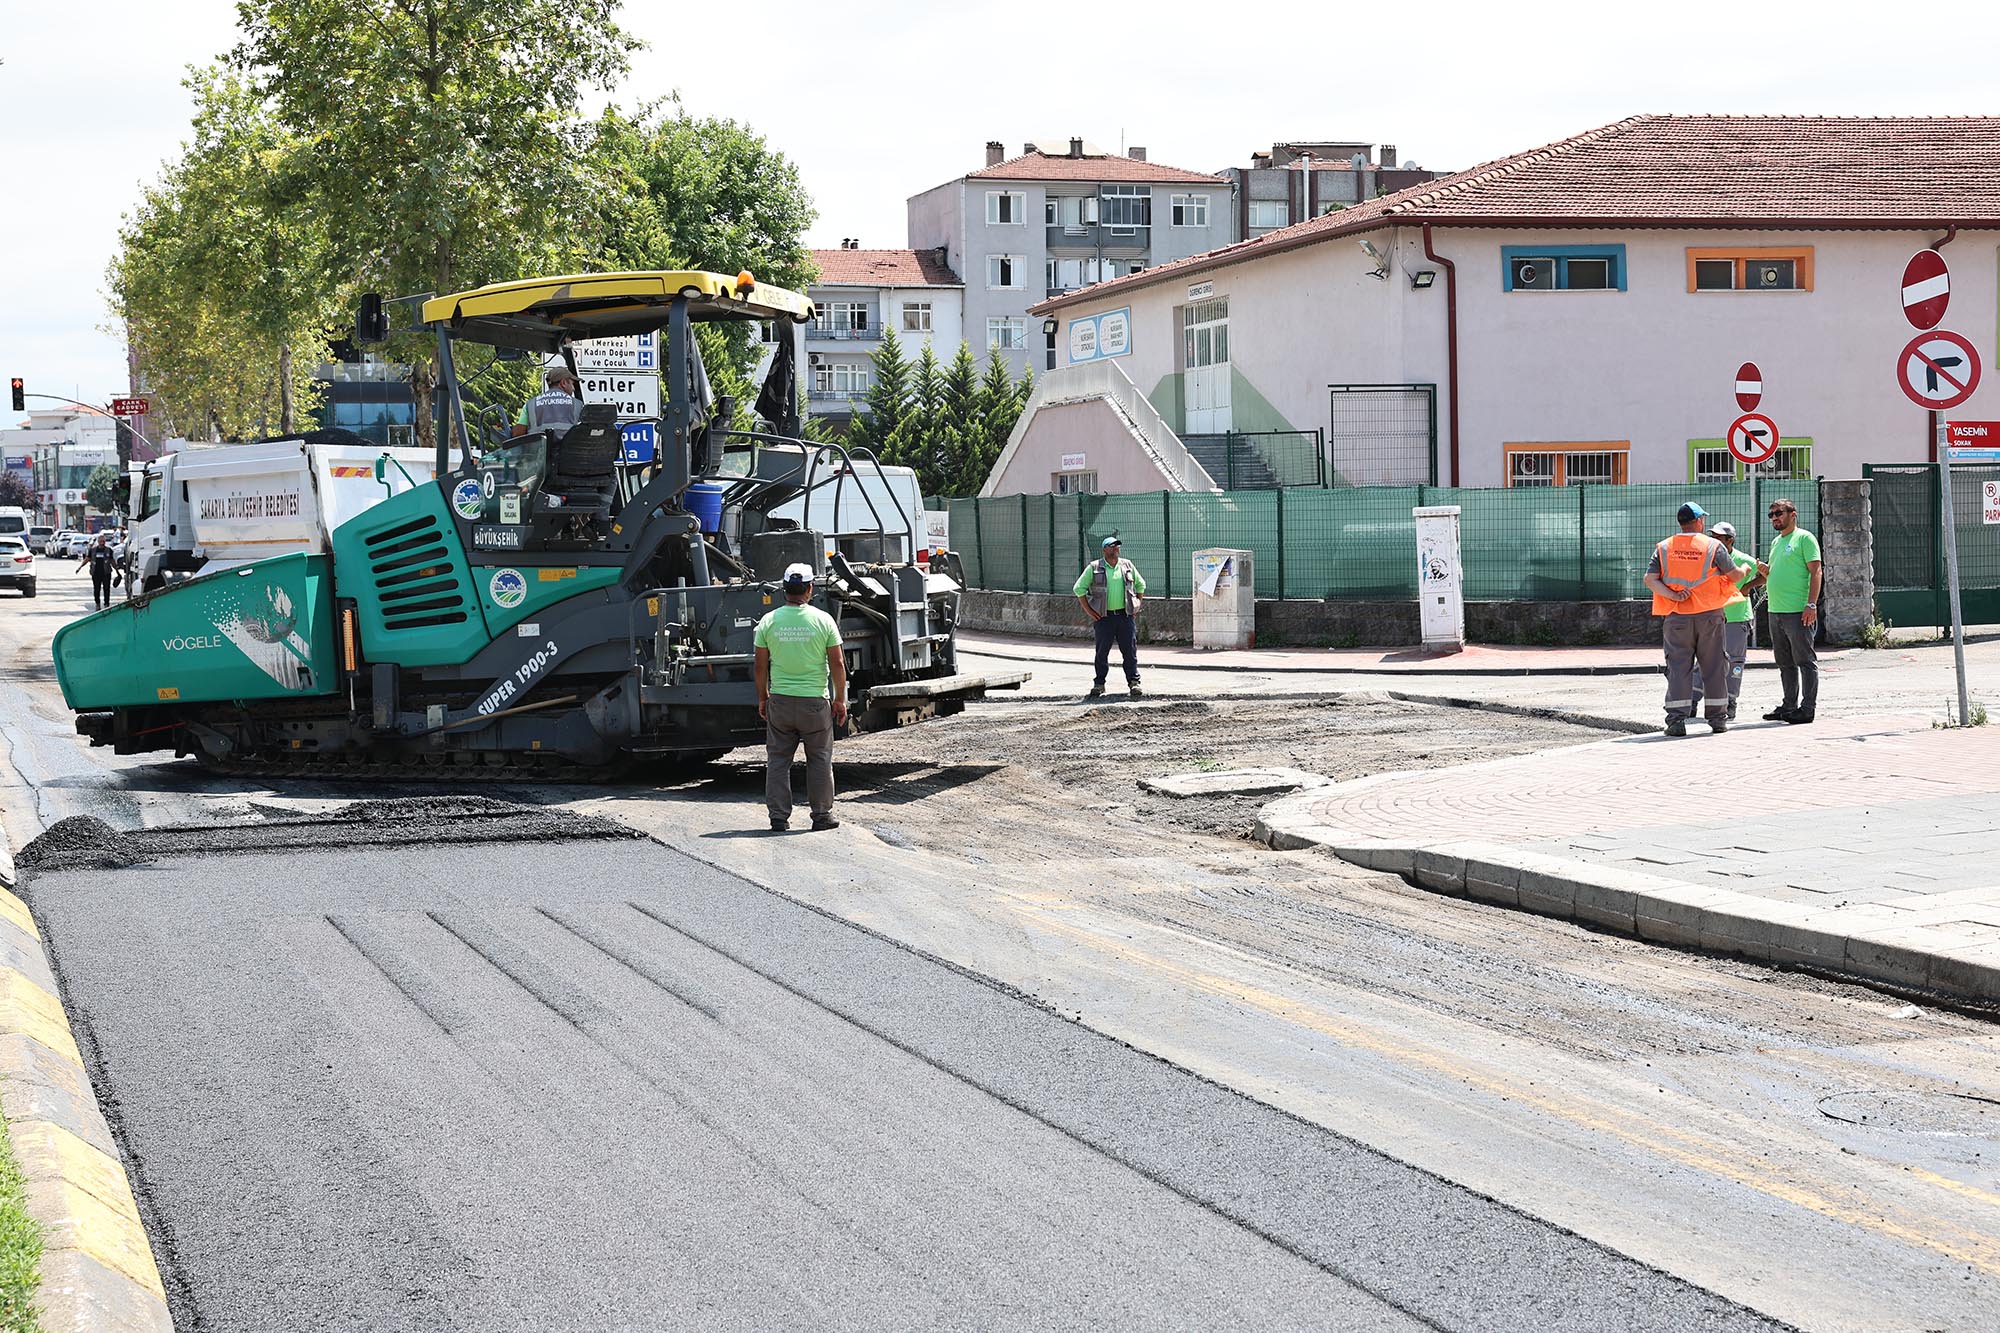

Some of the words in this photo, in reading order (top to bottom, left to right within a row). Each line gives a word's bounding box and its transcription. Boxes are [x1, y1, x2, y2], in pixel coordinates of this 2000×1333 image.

[609, 349, 635, 358] Doğum
[604, 359, 627, 367] Çocuk
[582, 377, 635, 392] enler
[1953, 425, 1988, 436] YASEMİN
[486, 475, 493, 495] 2
[201, 498, 226, 519] SAKARYA
[228, 490, 263, 520] BÜYÜKŞEHİR
[266, 488, 299, 516] BELEDİYESİ
[475, 528, 519, 547] BÜYÜKŞEHİR
[162, 635, 222, 651] VÖGELE
[478, 680, 517, 716] SUPER
[515, 641, 559, 684] 1900-3
